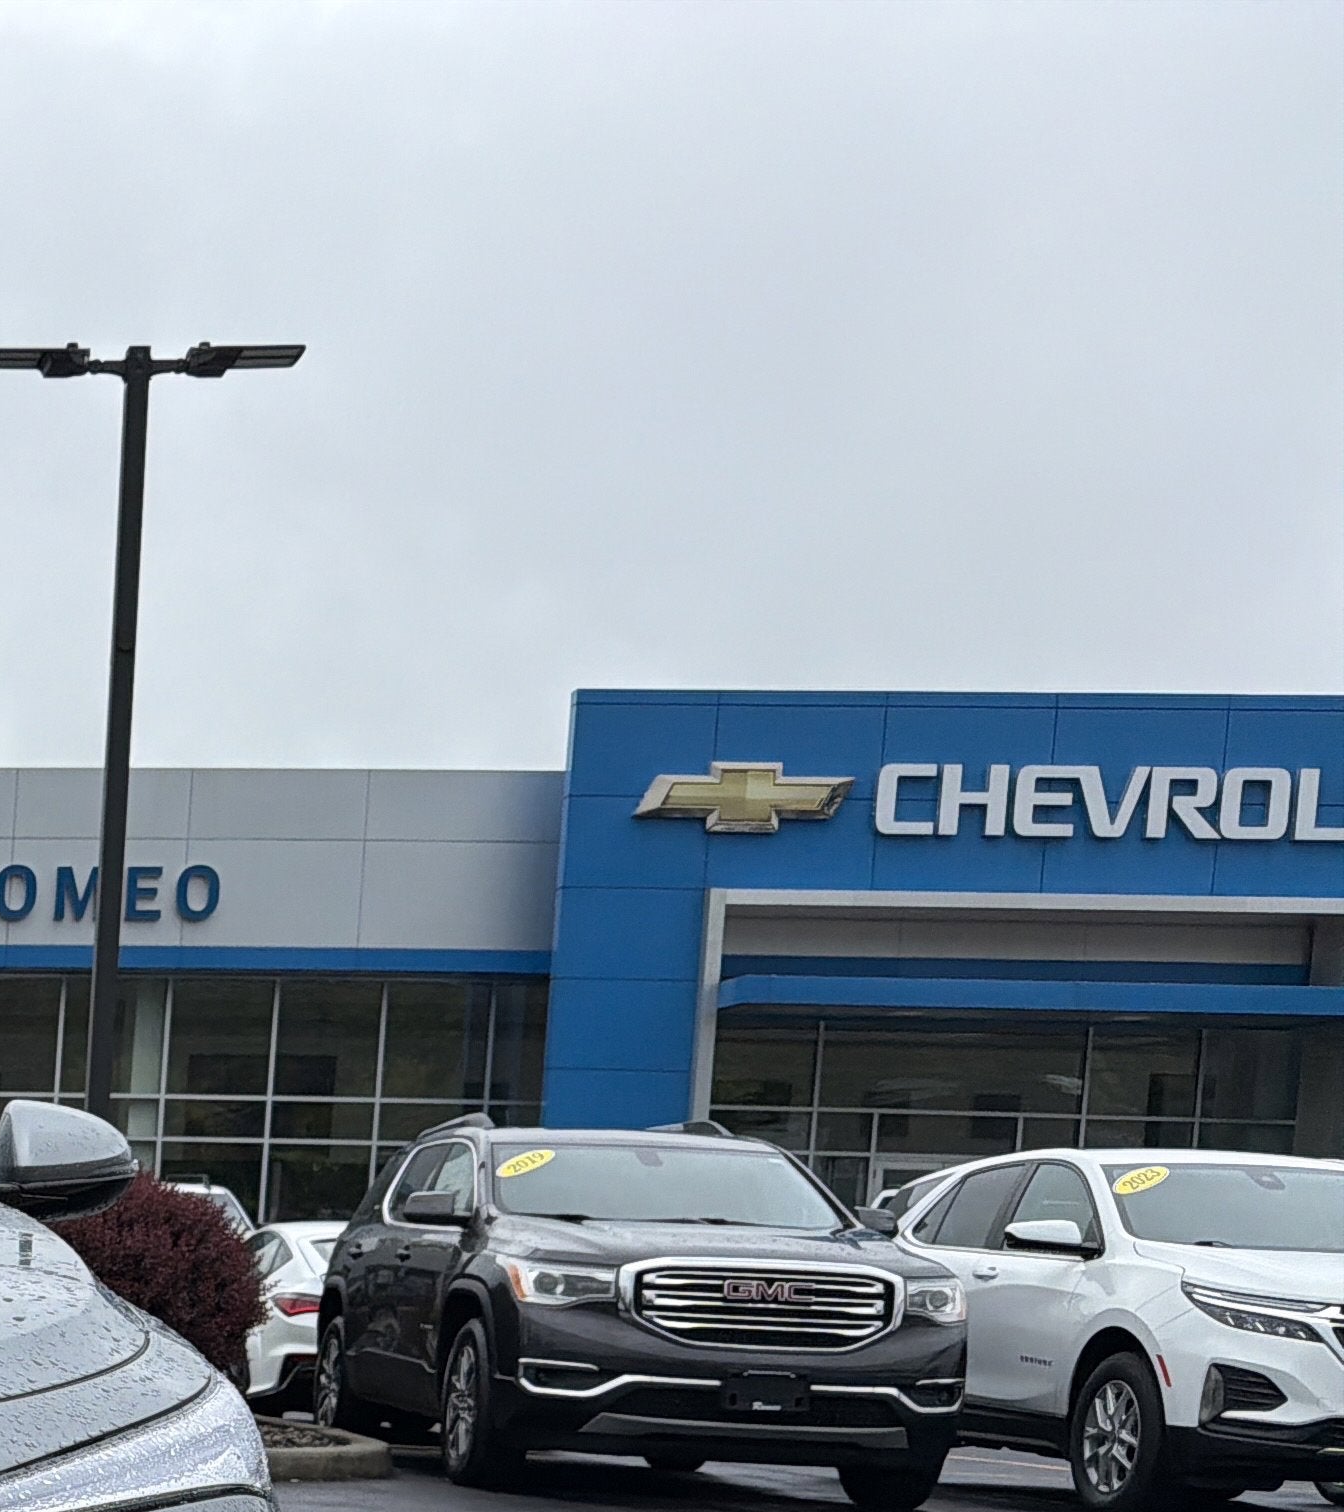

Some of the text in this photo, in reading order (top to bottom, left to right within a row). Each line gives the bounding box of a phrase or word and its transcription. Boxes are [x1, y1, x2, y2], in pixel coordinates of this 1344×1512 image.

[875, 763, 1344, 842] CHEVROL
[507, 1151, 545, 1173] 2019
[1122, 1168, 1161, 1190] 2023
[723, 1279, 816, 1302] GMC
